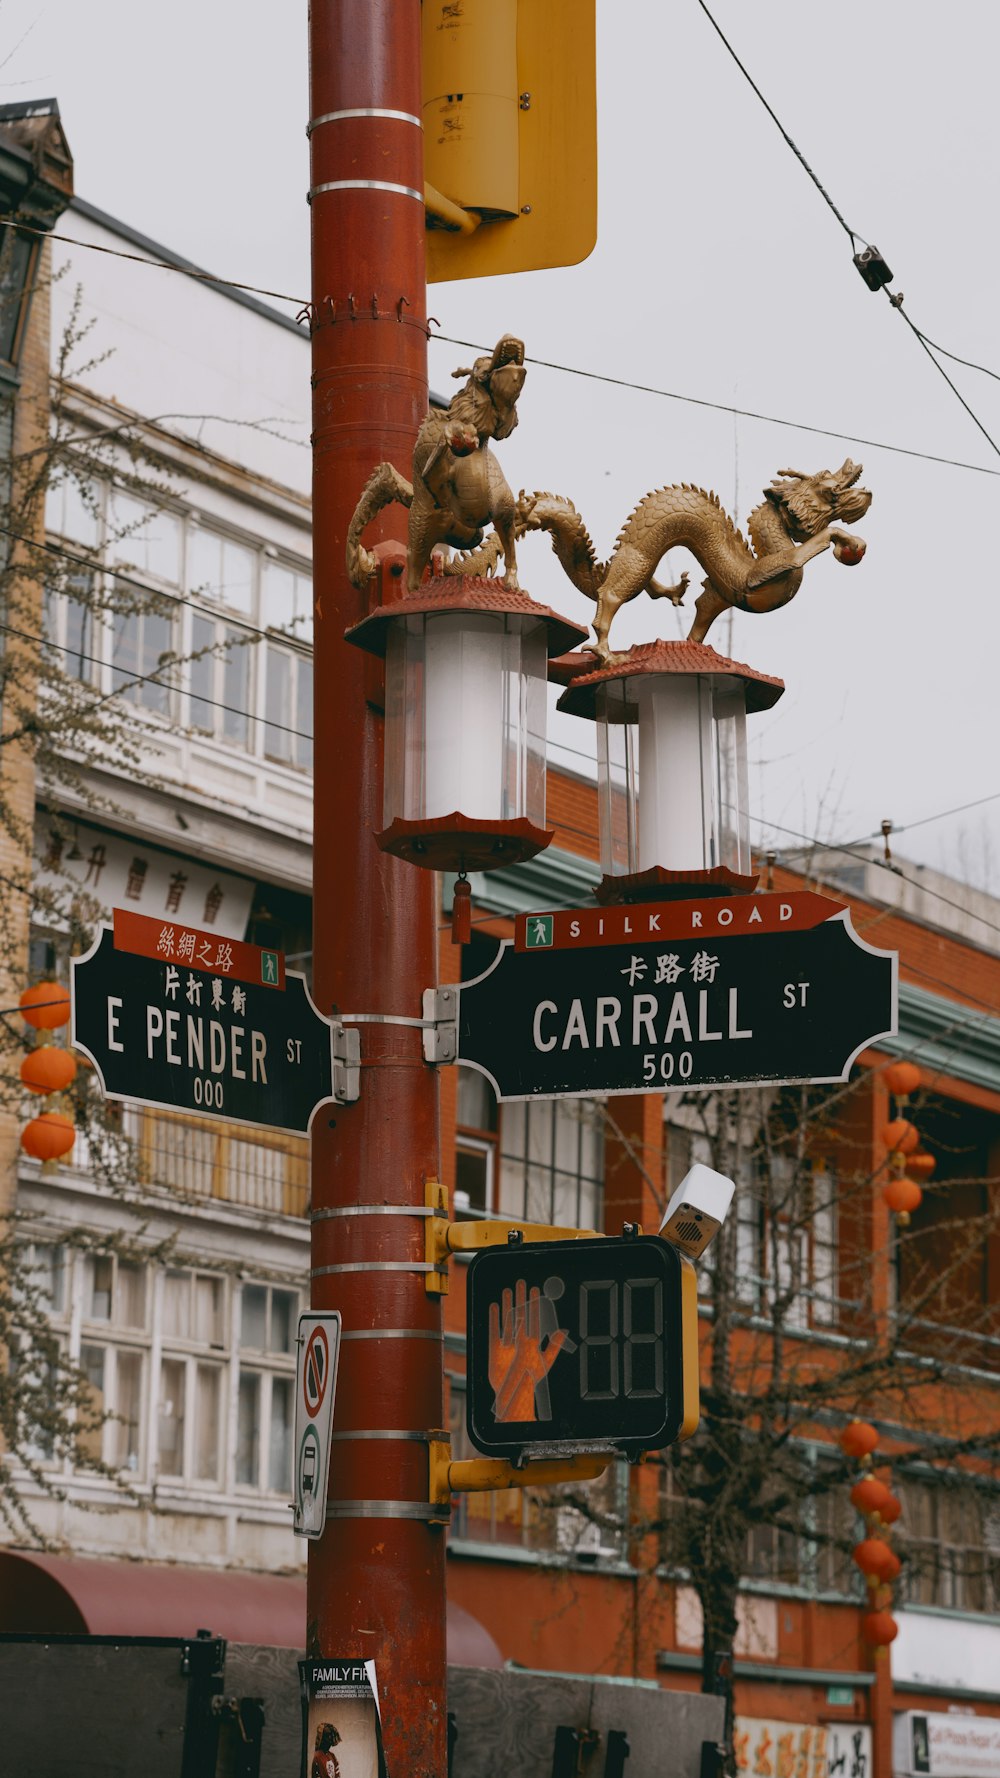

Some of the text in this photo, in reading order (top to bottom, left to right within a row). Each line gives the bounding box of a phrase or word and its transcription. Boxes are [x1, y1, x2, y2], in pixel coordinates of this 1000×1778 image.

[569, 904, 793, 939] SILK ROAD
[156, 926, 234, 973] 絲綢之路
[620, 950, 720, 987] 卡路街
[164, 965, 247, 1017] 片打東街
[532, 982, 811, 1053] CARRALL ST
[107, 996, 302, 1084] E PENDER ST
[642, 1052, 694, 1081] 500
[194, 1077, 224, 1109] 000
[312, 1667, 350, 1682] FAMILY
